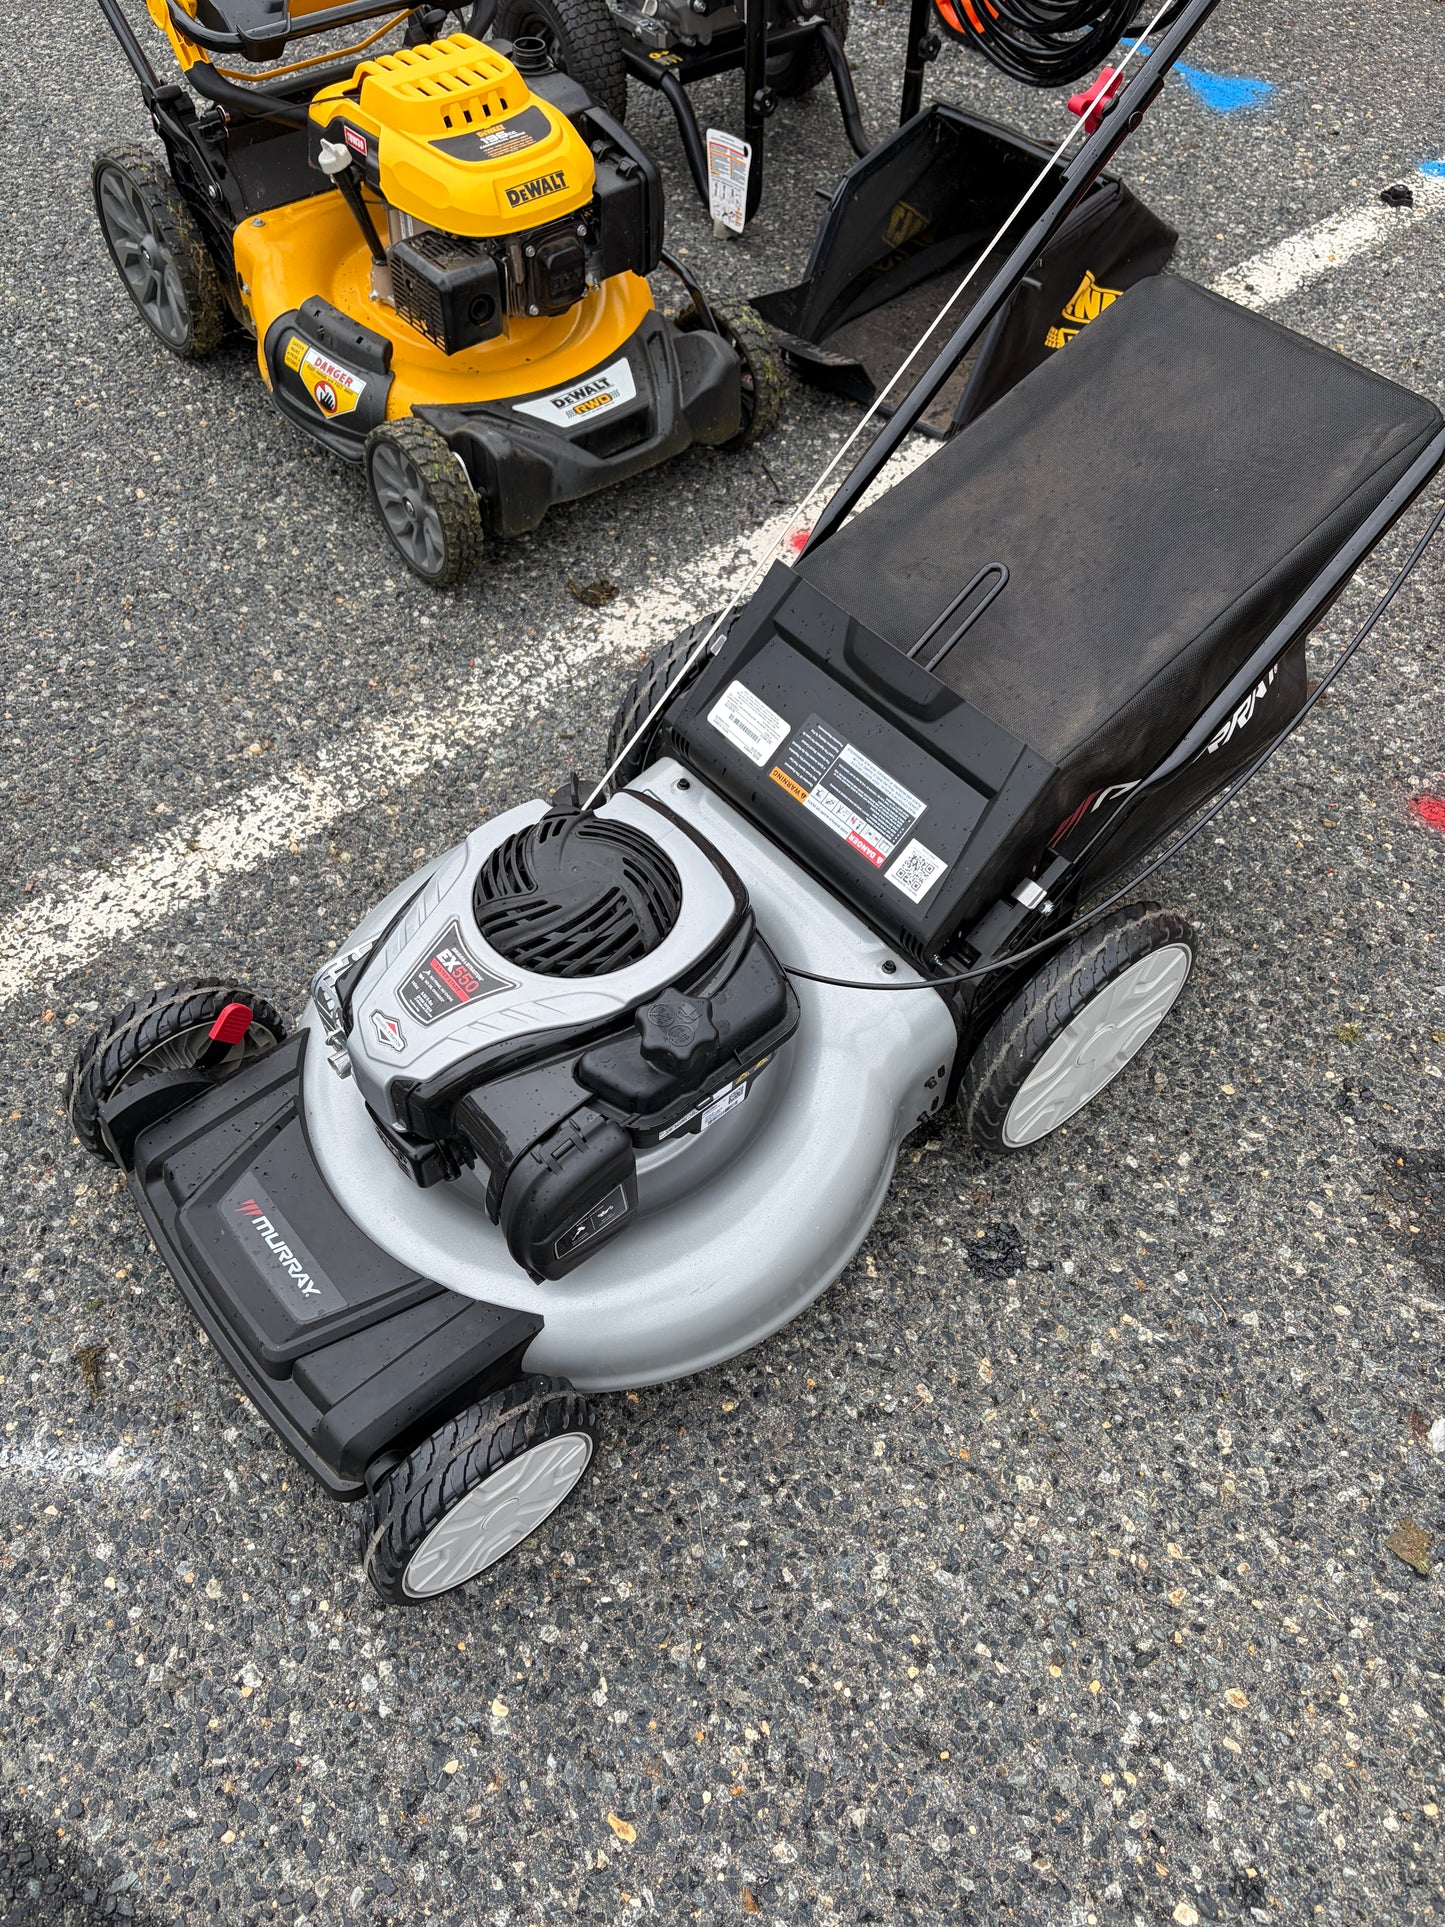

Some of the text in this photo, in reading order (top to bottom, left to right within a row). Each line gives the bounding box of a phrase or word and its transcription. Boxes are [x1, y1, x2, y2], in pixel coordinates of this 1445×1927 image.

[505, 171, 568, 207] DEWALT
[314, 357, 354, 388] DANGER
[552, 378, 611, 409] DEWALT
[575, 395, 612, 415] RWD
[773, 770, 801, 795] WARNING
[848, 833, 876, 859] DANGER
[436, 948, 479, 993] EX550
[251, 1215, 321, 1296] MURRAY
